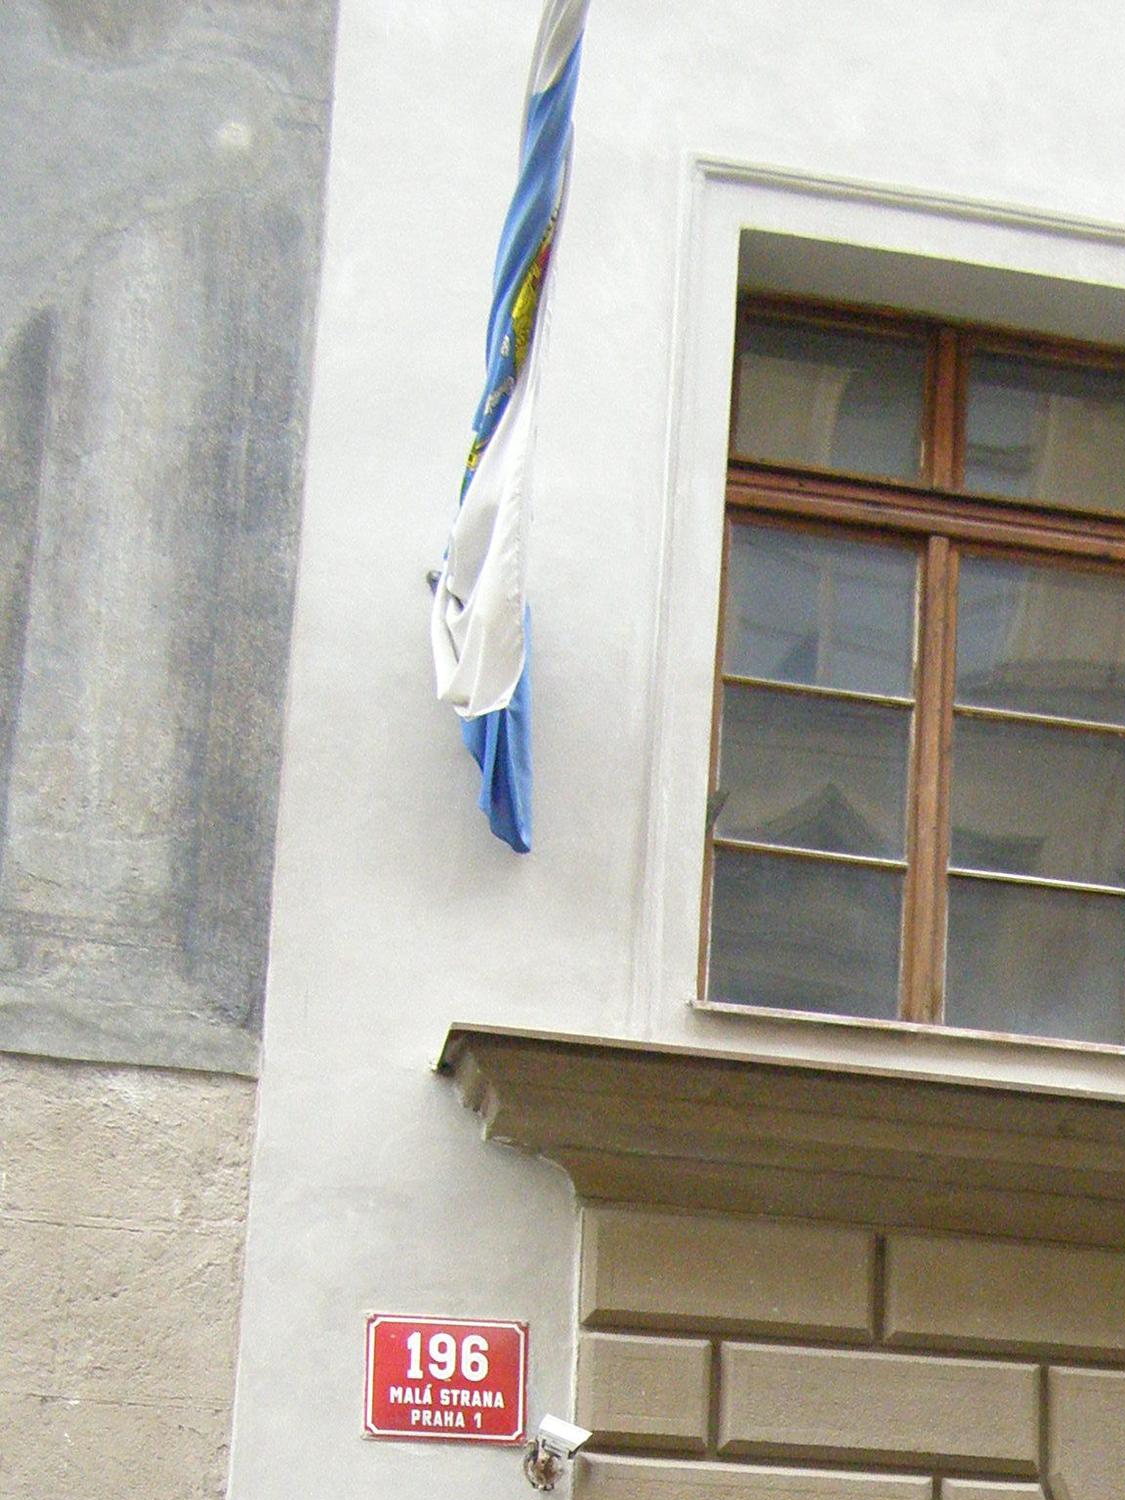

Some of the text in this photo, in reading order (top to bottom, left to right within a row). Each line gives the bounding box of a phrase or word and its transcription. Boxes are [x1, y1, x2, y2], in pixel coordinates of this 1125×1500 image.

[406, 1331, 490, 1382] 196
[389, 1384, 505, 1409] MALÁ STRANA
[410, 1409, 483, 1429] PRAHA 1
